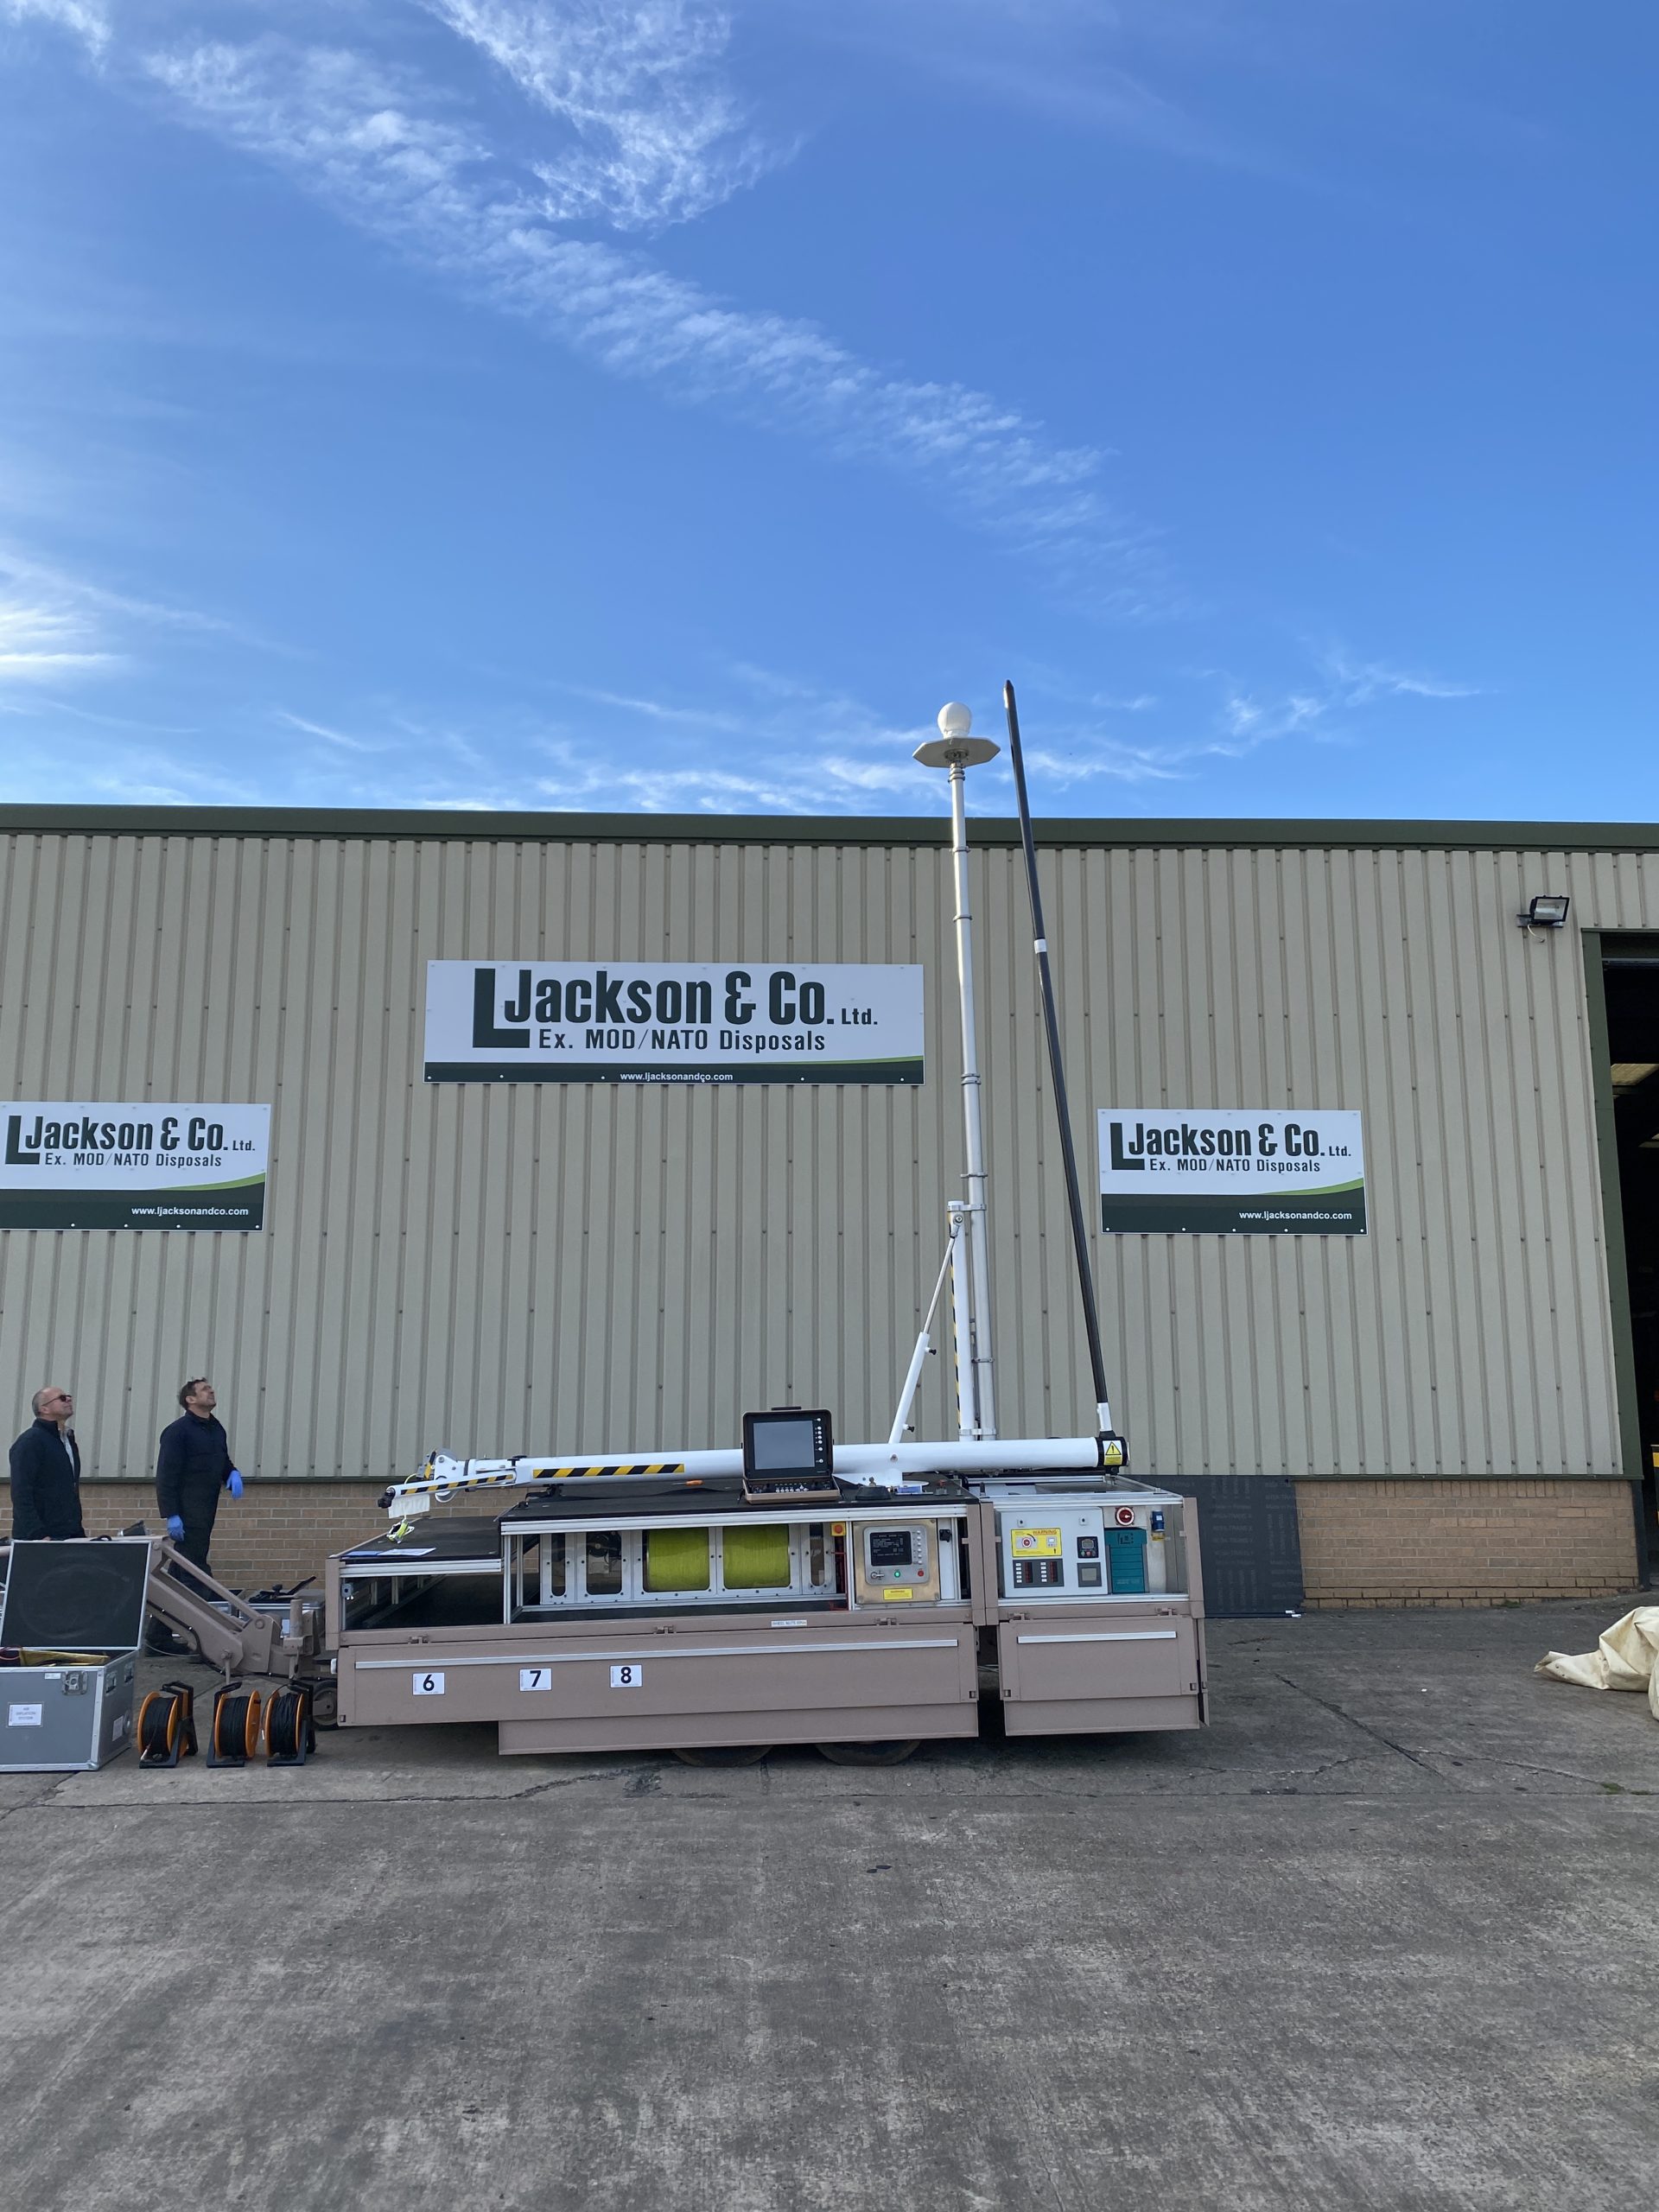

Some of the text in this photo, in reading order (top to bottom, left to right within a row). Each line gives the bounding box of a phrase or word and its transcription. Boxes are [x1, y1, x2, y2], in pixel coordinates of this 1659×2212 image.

[724, 970, 757, 1026] &
[768, 970, 835, 1026] Co.
[841, 1007, 879, 1026] Ltd.
[538, 1028, 825, 1054] Ex. MOD/NATO Disposals
[160, 1116, 181, 1151] &
[188, 1116, 229, 1151] Co.
[232, 1140, 256, 1152] Ltd.
[1258, 1122, 1278, 1157] &
[1284, 1123, 1325, 1157] Co.
[1328, 1146, 1351, 1157] Ltd.
[45, 1152, 222, 1169] Ex. MOD/NATO Disposals
[1149, 1158, 1320, 1174] Ex. MOD/NATO Disposals
[131, 1206, 249, 1217] www.ljacksonandco.com
[1238, 1211, 1352, 1221] www.ljacksonandco.com
[423, 1674, 435, 1692] 6
[530, 1669, 542, 1688] 7
[620, 1666, 632, 1684] 8
